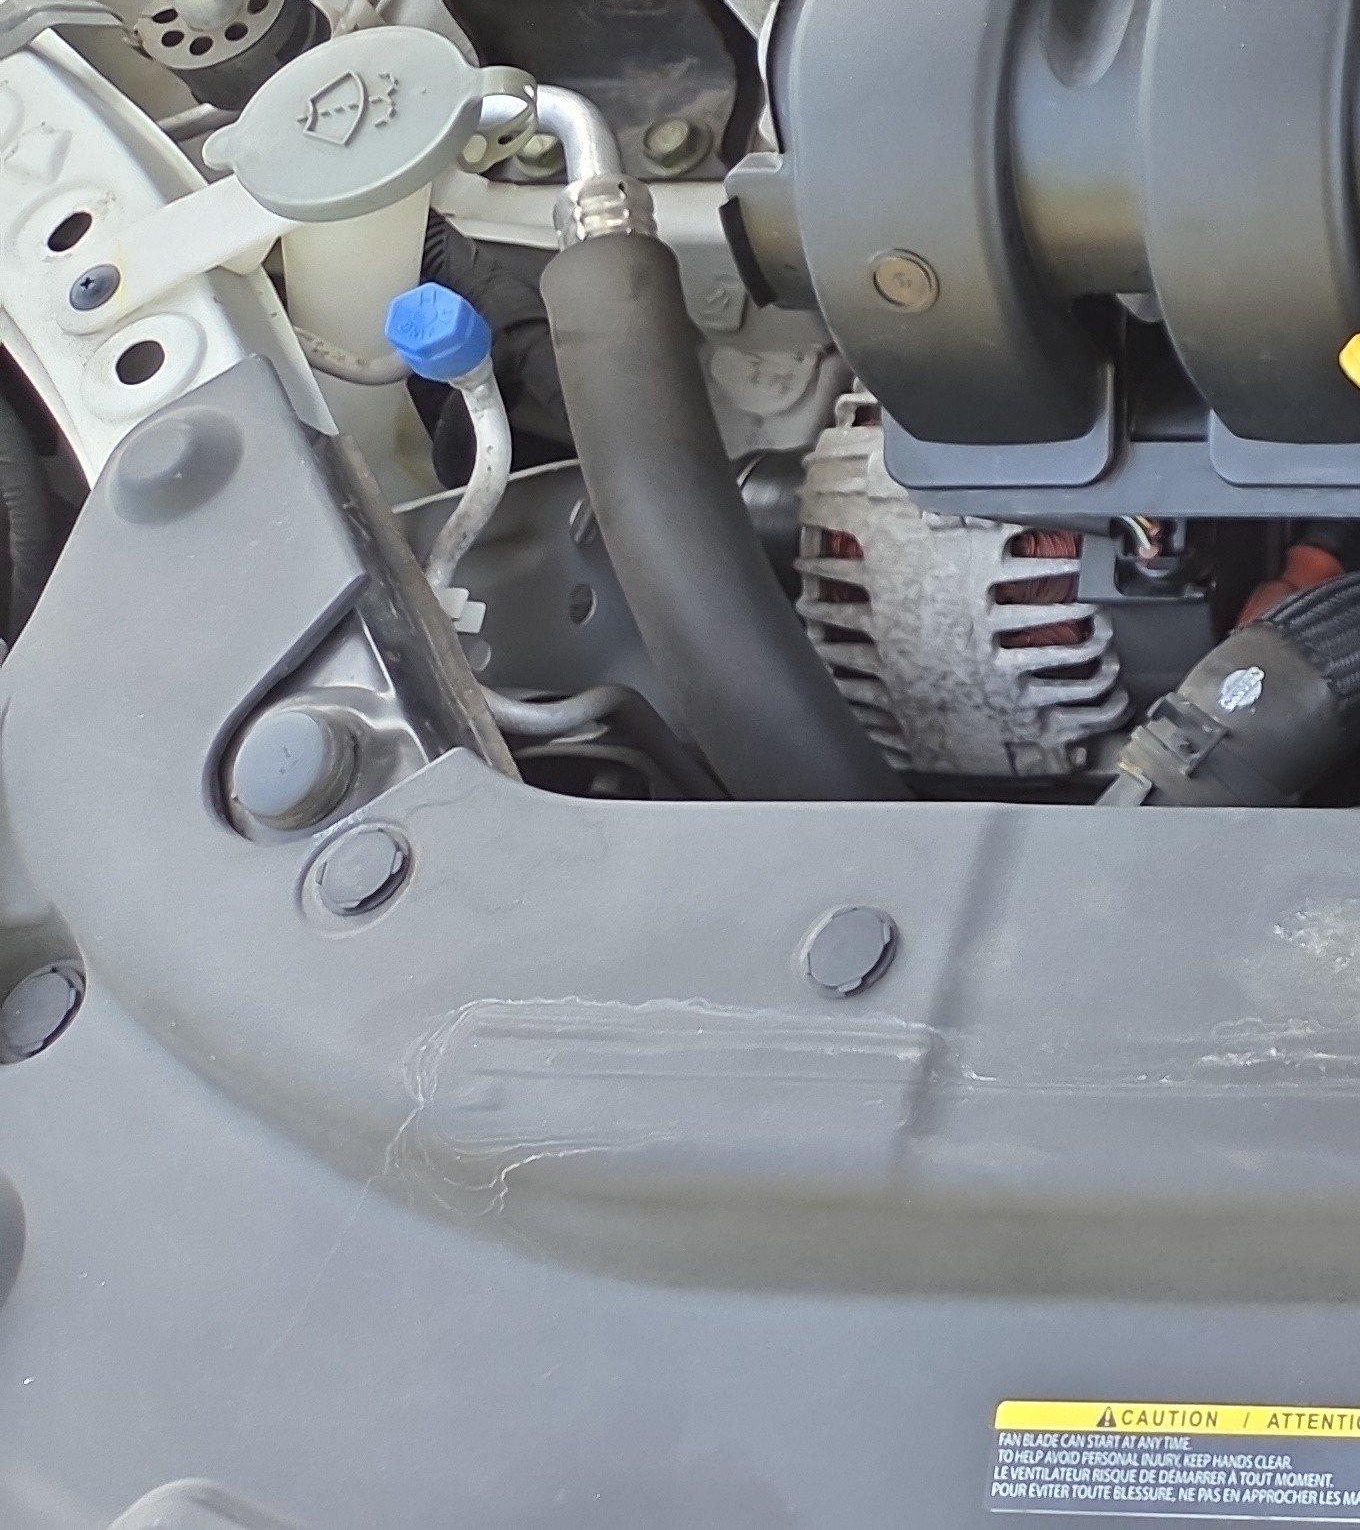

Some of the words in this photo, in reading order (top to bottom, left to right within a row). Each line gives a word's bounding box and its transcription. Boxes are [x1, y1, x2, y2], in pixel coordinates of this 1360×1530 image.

[1121, 1409, 1218, 1428] CAUTION
[1242, 1411, 1250, 1428] /
[998, 1432, 1022, 1447] FAN
[1022, 1433, 1058, 1448] BLADE
[1060, 1434, 1085, 1449] CAN
[1086, 1435, 1120, 1449] START
[1121, 1436, 1137, 1449] AT
[1137, 1437, 1164, 1450] ANY
[1163, 1437, 1192, 1450] TIME.
[998, 1449, 1013, 1463] TO
[1014, 1449, 1043, 1464] HELP
[1043, 1450, 1080, 1464] AVOID
[1081, 1451, 1139, 1466] PERSONAL
[1183, 1453, 1212, 1468] KEEP
[1212, 1454, 1253, 1468] HANDS
[1254, 1455, 1293, 1469] CLEAR.
[993, 1466, 1008, 1480] LE
[1009, 1466, 1090, 1482] VENTILATEUR
[1091, 1469, 1137, 1483] RISQUE
[1138, 1470, 1158, 1483] DE
[1239, 1472, 1274, 1486] TOUT
[1274, 1473, 1334, 1488] MOMENT.
[991, 1482, 1028, 1497] POUR
[1071, 1484, 1111, 1499] TOUTE
[1113, 1486, 1176, 1502] BLESSURE,
[1178, 1487, 1196, 1501] NE
[1197, 1488, 1222, 1502] PAS
[1222, 1488, 1241, 1502] EN
[1241, 1489, 1319, 1505] APPROCHER
[1319, 1491, 1342, 1505] LES
